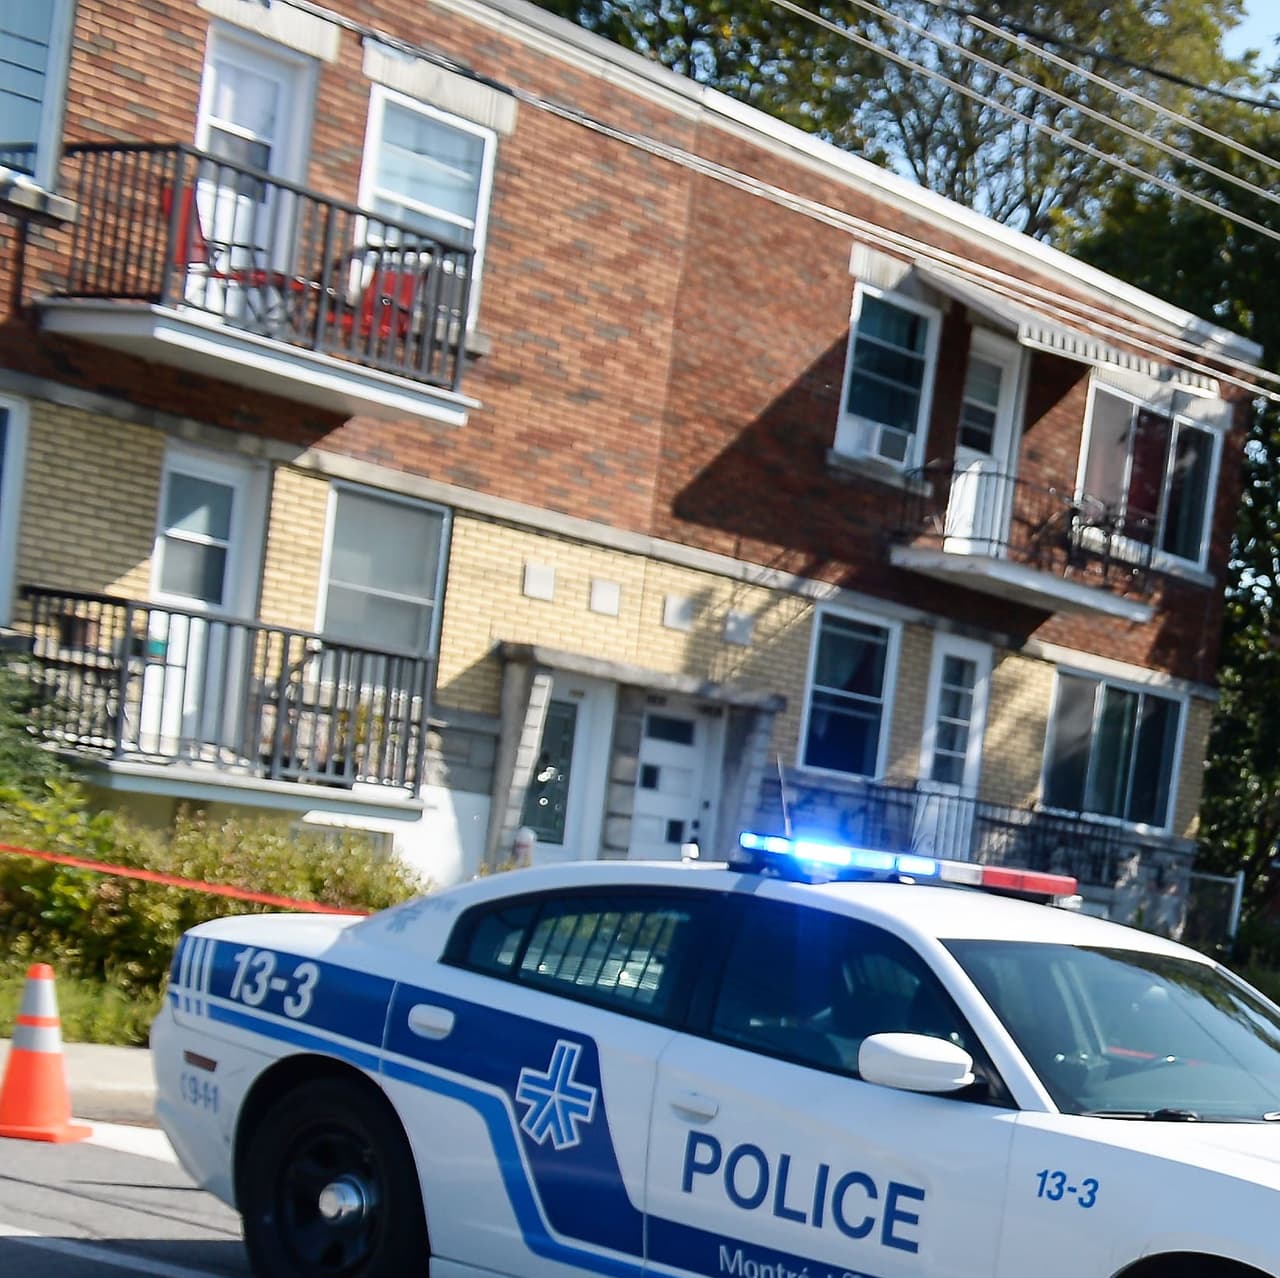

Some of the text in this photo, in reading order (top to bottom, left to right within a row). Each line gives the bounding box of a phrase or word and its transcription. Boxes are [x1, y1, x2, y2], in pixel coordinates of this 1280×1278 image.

[229, 946, 320, 1019] 13-3
[681, 1129, 926, 1254] POLICE
[1036, 1168, 1099, 1209] 13-3
